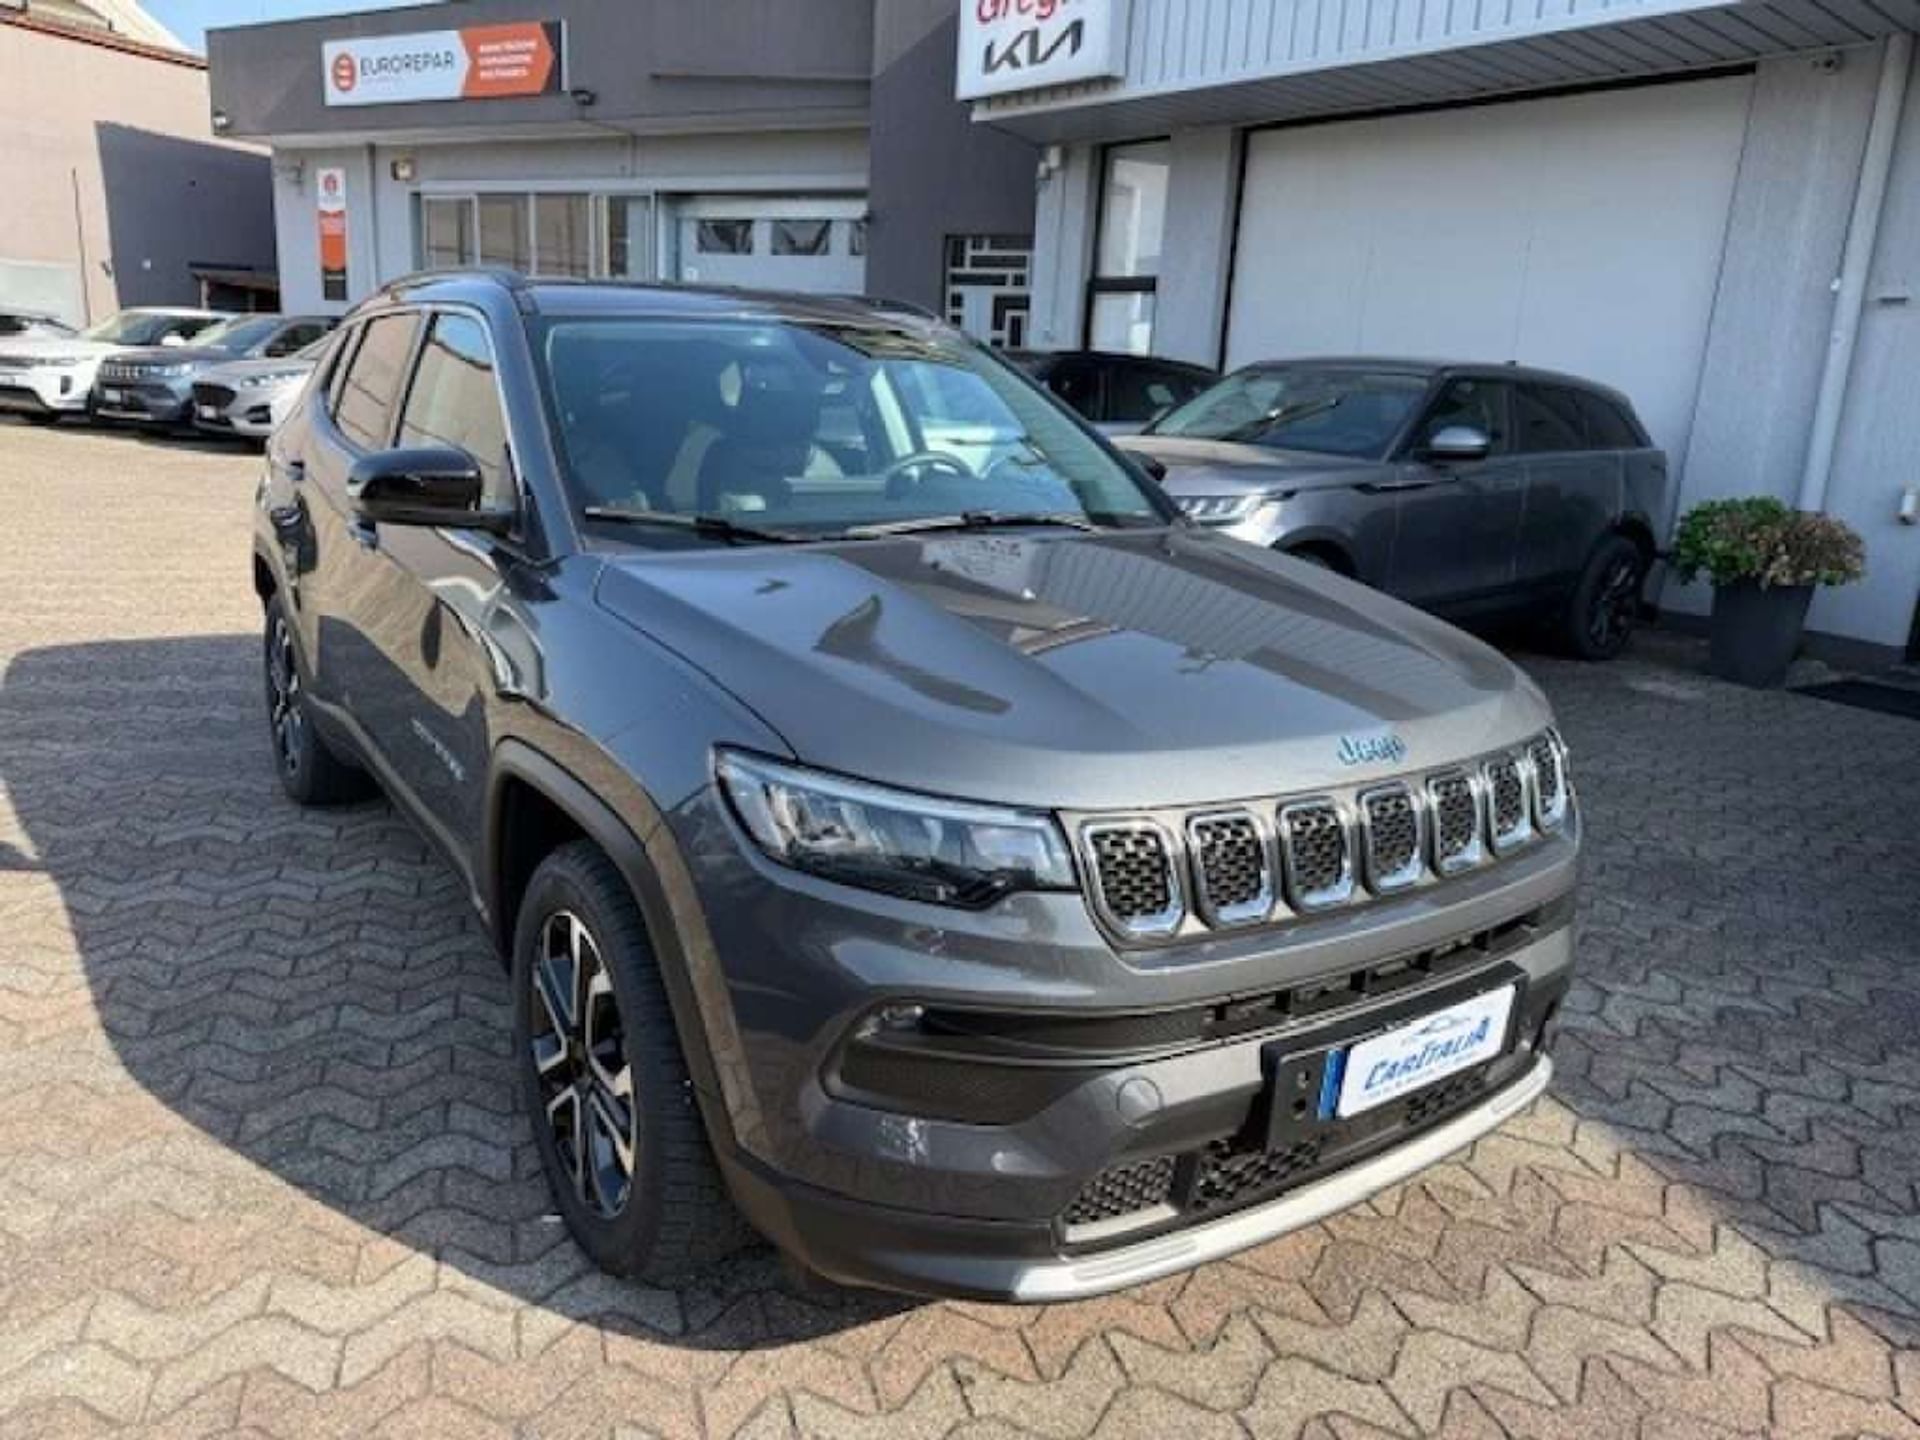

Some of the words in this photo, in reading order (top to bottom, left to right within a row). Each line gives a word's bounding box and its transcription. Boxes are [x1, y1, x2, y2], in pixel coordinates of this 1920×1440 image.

[983, 19, 1084, 74] KIA
[359, 51, 455, 76] EUROREPAR
[1338, 735, 1408, 766] Jeep
